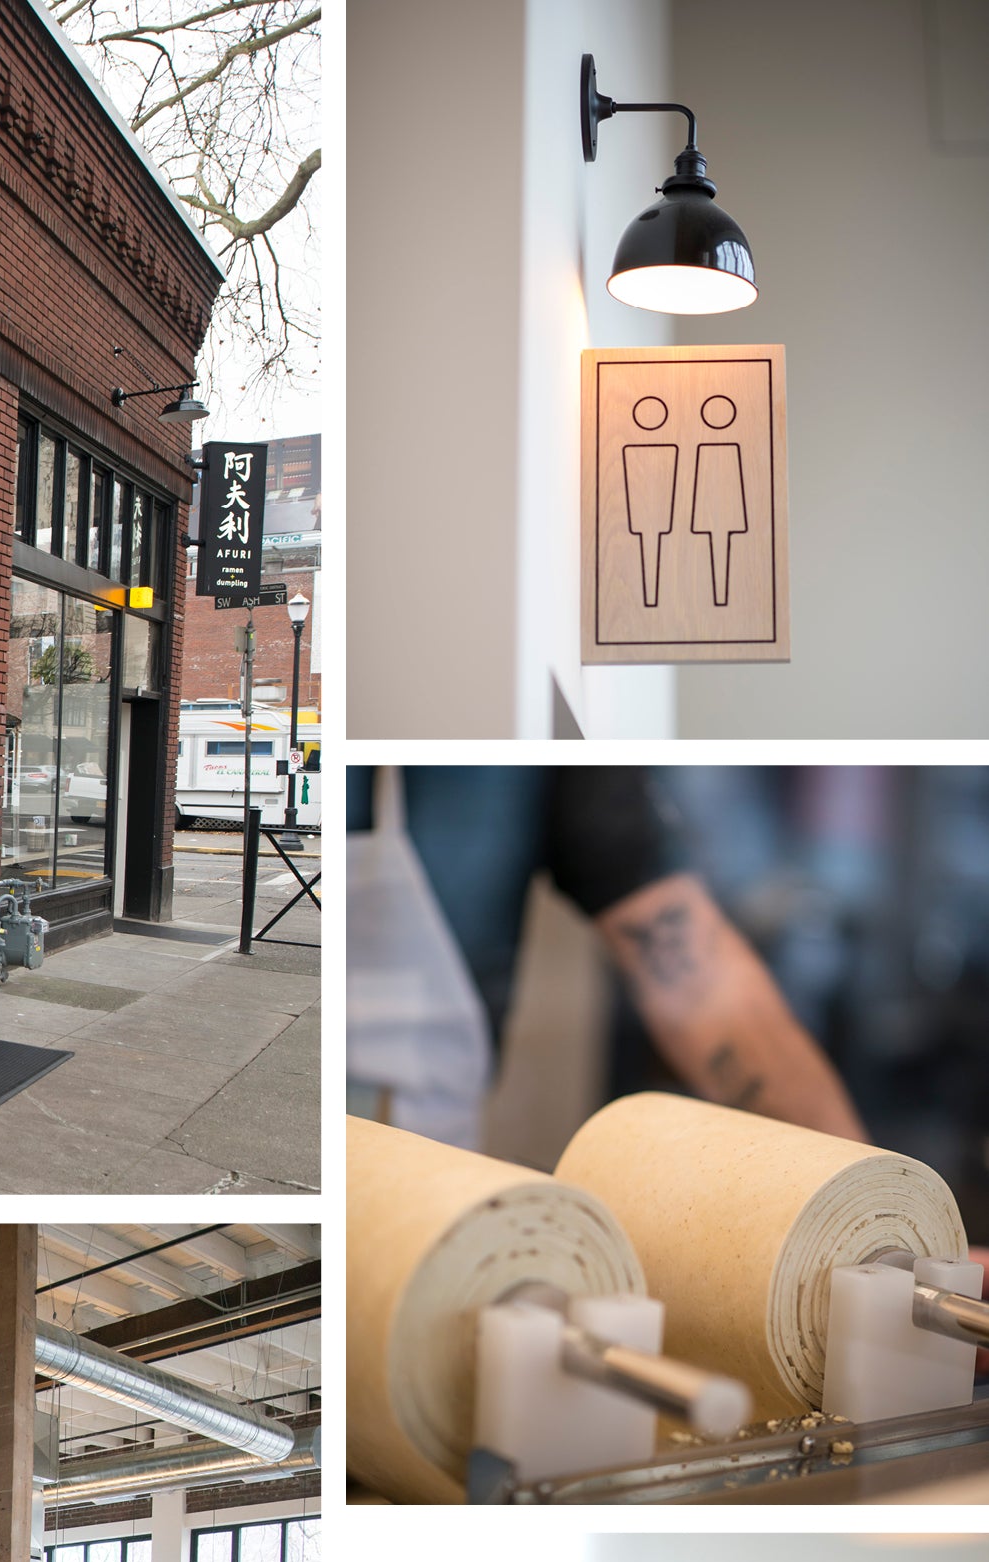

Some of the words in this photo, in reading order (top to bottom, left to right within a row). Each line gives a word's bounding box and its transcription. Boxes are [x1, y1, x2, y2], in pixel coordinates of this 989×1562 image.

[217, 451, 254, 544] 阿夫利
[216, 549, 252, 559] AFURI
[221, 566, 244, 574] ramen
[216, 579, 248, 588] dumpling
[217, 597, 231, 608] SW
[242, 597, 260, 606] ASH
[275, 593, 286, 604] ST
